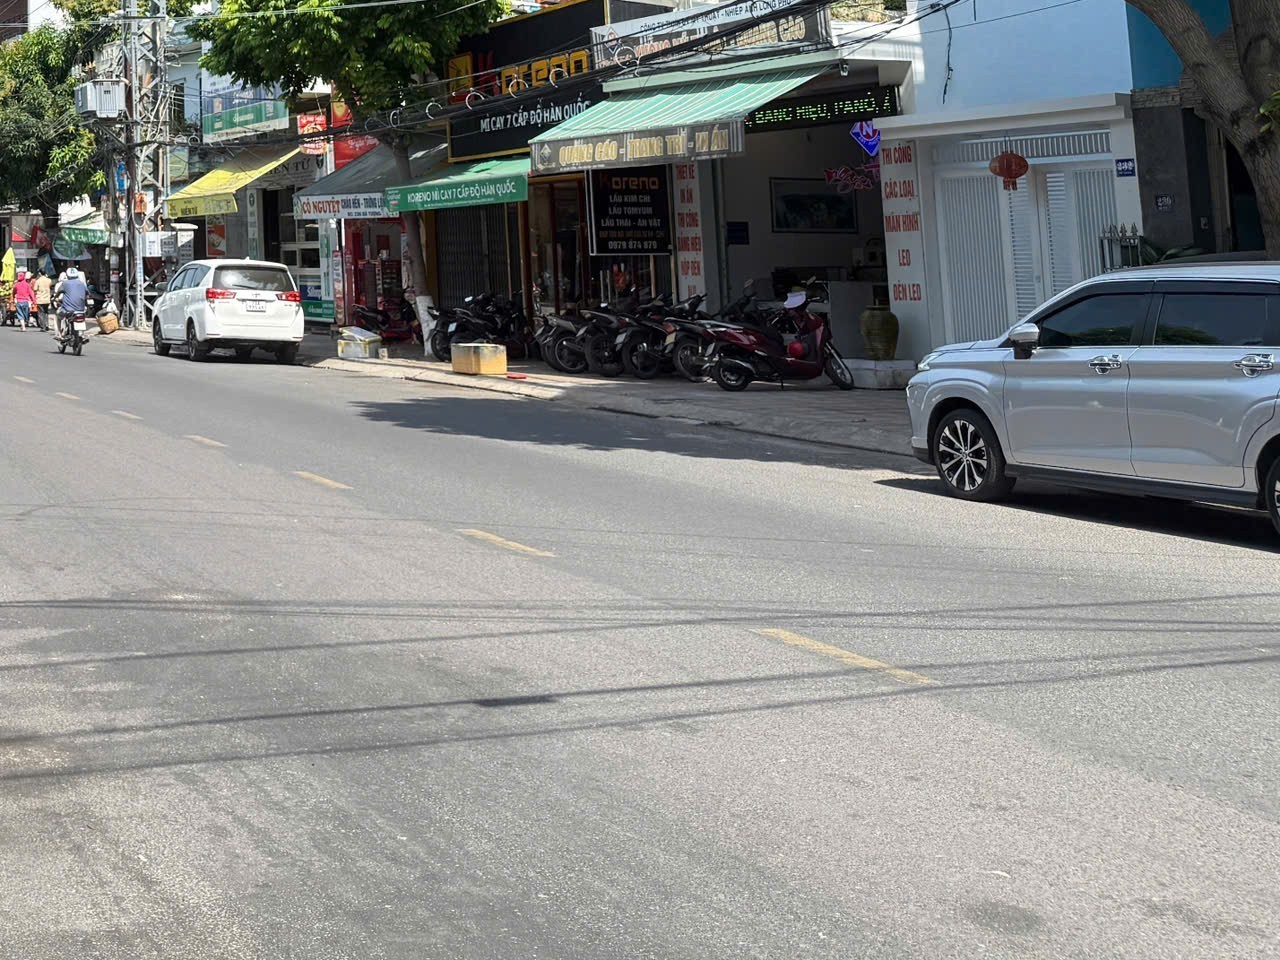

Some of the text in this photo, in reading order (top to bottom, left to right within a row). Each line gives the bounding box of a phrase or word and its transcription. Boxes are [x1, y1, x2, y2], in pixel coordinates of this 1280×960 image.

[490, 116, 505, 131] CAY
[506, 116, 511, 129] 7
[512, 105, 528, 127] CẤP
[530, 100, 541, 127] ĐỘ
[544, 102, 562, 123] HÀN
[559, 141, 593, 165] QUẢNG
[595, 139, 618, 161] CÁO
[628, 136, 663, 159] TRANG
[665, 133, 687, 155] TRÍ
[696, 132, 708, 152] IN
[710, 125, 729, 151] ẤN
[882, 143, 912, 165] THI CÔNG
[440, 190, 453, 200] CAY
[457, 184, 470, 198] CẤP
[470, 184, 480, 198] ĐỘ
[481, 183, 495, 196] HÀN
[496, 178, 516, 196] QUỐC
[884, 178, 915, 201] CÁC LOẠI
[303, 198, 311, 214] CÔ
[313, 197, 340, 217] NGUYỆT
[885, 210, 919, 233] MÀN HÌNH
[893, 279, 907, 301] ĐÈN
